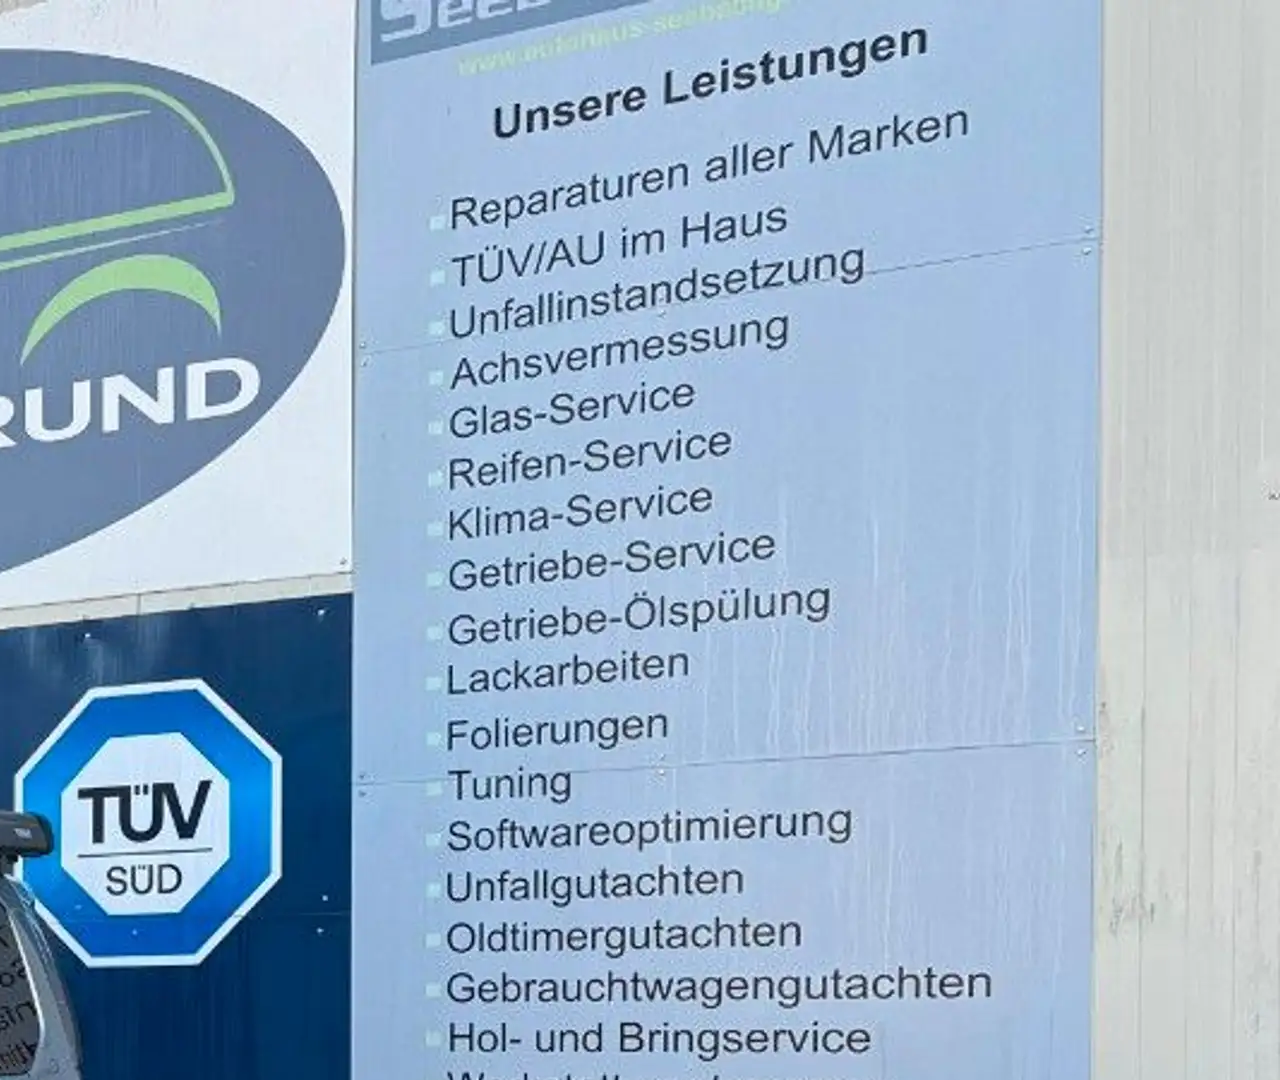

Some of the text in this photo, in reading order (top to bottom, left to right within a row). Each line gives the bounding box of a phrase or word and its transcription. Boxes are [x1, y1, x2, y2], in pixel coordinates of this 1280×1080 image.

[494, 29, 927, 139] Unsere Leistungen
[452, 111, 968, 230] Reparaturen aller Marken
[451, 207, 787, 287] TÜV/AU im Haus
[450, 249, 863, 339] Unfallinstandsetzung
[450, 316, 788, 390] Achsvermessung
[450, 382, 695, 438] Glas-Service
[450, 429, 731, 490] Reifen-Service
[450, 485, 712, 540] Klima-Service
[449, 532, 775, 591] Getriebe-Service
[448, 588, 830, 645] Getriebe-Ölspülung
[448, 651, 688, 695] Lackarbeiten
[447, 714, 667, 751] Folierungen
[77, 779, 213, 844] TÜV
[448, 766, 571, 804] Tuning
[448, 809, 851, 852] Softwareoptimierung
[106, 863, 182, 896] SÜD
[447, 864, 743, 908] Unfallgutachten
[447, 916, 801, 959] Oldtimergutachten
[447, 966, 991, 1009] Gebrauchtwagengutachten
[450, 1021, 871, 1061] Hol- und Bringservice
